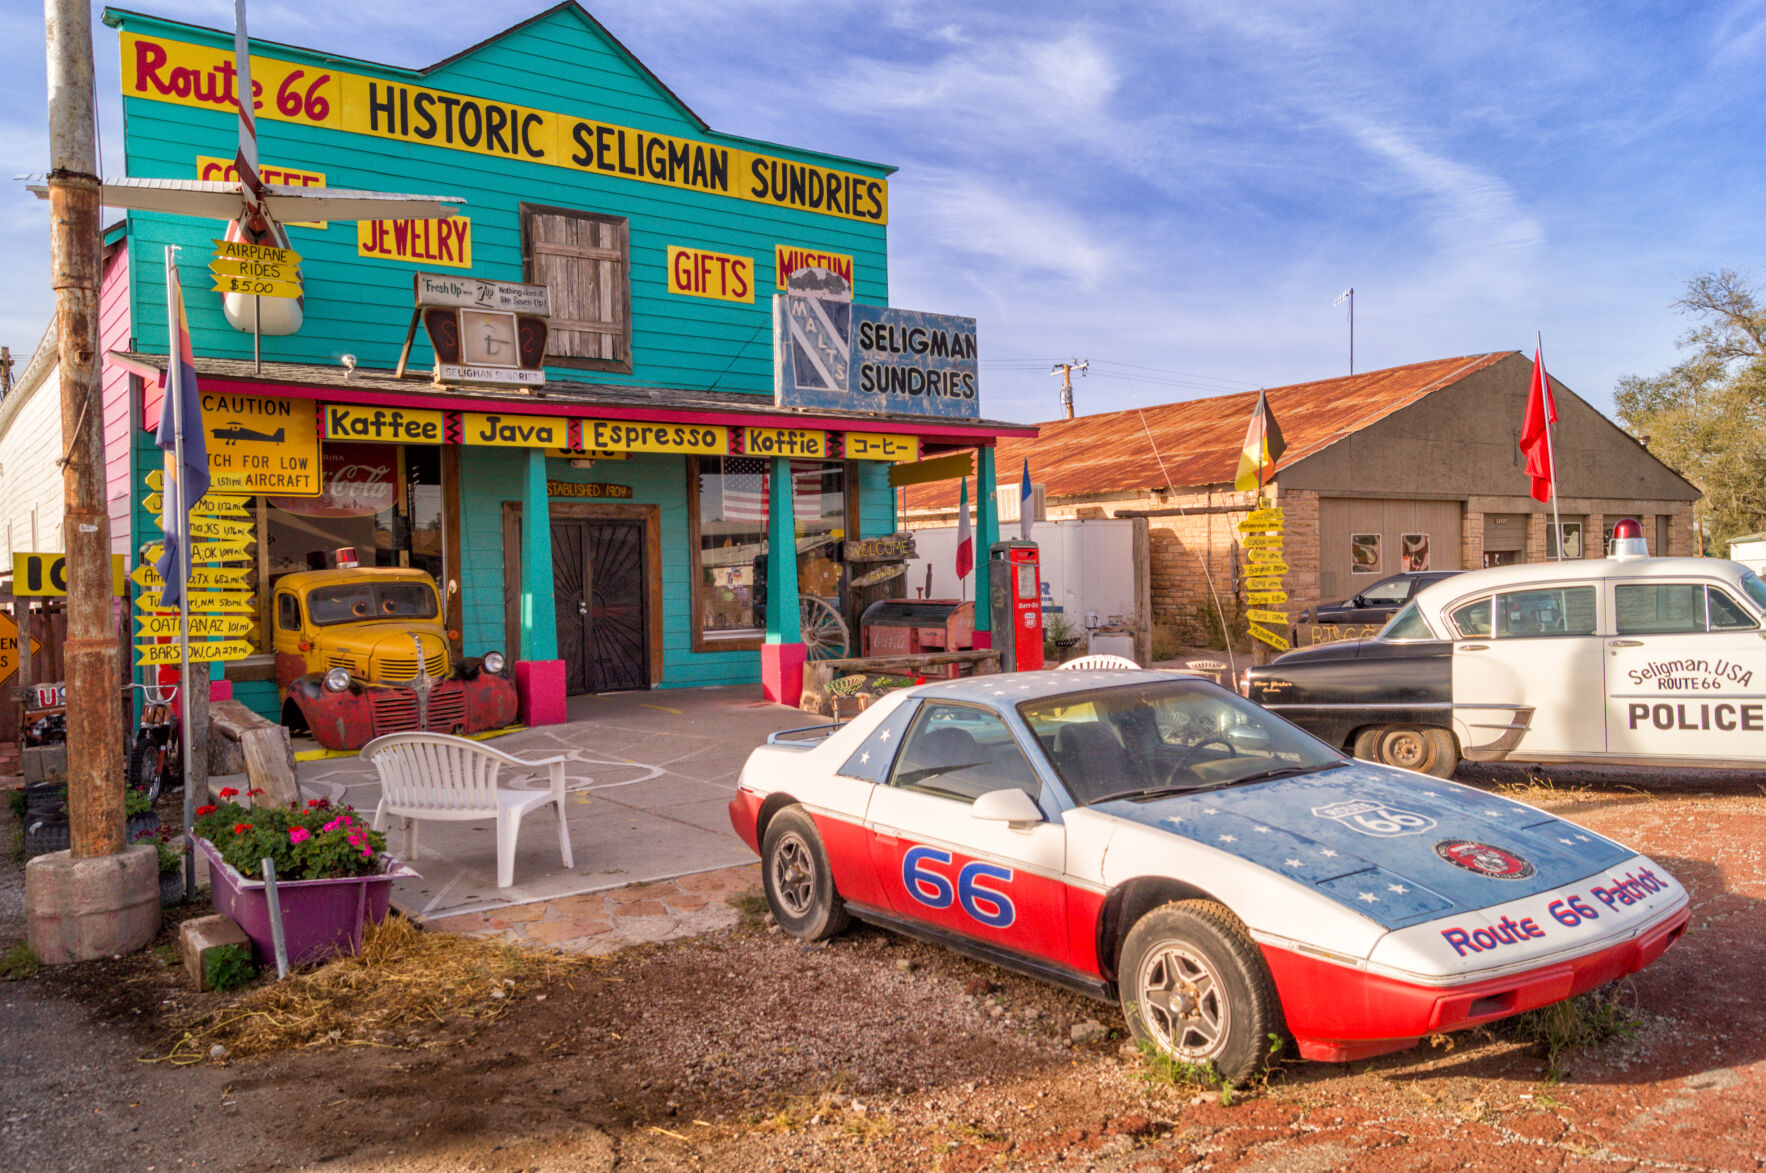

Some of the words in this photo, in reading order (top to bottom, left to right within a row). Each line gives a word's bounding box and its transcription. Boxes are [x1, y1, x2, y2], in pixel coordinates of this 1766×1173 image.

[134, 40, 264, 110] Route
[276, 70, 331, 121] 66
[369, 82, 545, 158] HISTORIC
[572, 122, 728, 192] SELIGMAN
[751, 158, 883, 220] SUNDRIES
[226, 243, 289, 263] AIRPLANE
[362, 219, 468, 264] JEWELRY
[240, 262, 281, 278] RIDES
[674, 251, 748, 298] GIFTS
[229, 277, 274, 294] $5.00
[859, 320, 978, 360] SELIGMAN
[860, 363, 976, 400] SUNDRIES
[202, 395, 291, 417] CAUTION
[331, 408, 438, 439] Kaffee
[479, 416, 554, 445] Java
[593, 422, 718, 449] Espresso
[749, 424, 820, 455] Koffie
[854, 437, 908, 455] コーヒー
[206, 453, 232, 467] TCH
[243, 455, 269, 468] FOR
[280, 457, 308, 470] LOW
[322, 454, 345, 462] RINK
[245, 473, 310, 488] AIRCRAFT
[547, 482, 601, 497] STABLISHED
[849, 540, 909, 558] WELCOME
[1658, 678, 1699, 690] ROUTE
[1702, 678, 1721, 690] 66
[1715, 659, 1753, 687] USA
[1628, 703, 1765, 732] POLICE
[1353, 809, 1425, 833] 66
[901, 844, 1018, 929] 66
[1441, 916, 1546, 957] Route
[1548, 894, 1600, 928] 66
[1590, 866, 1670, 913] Patriot
